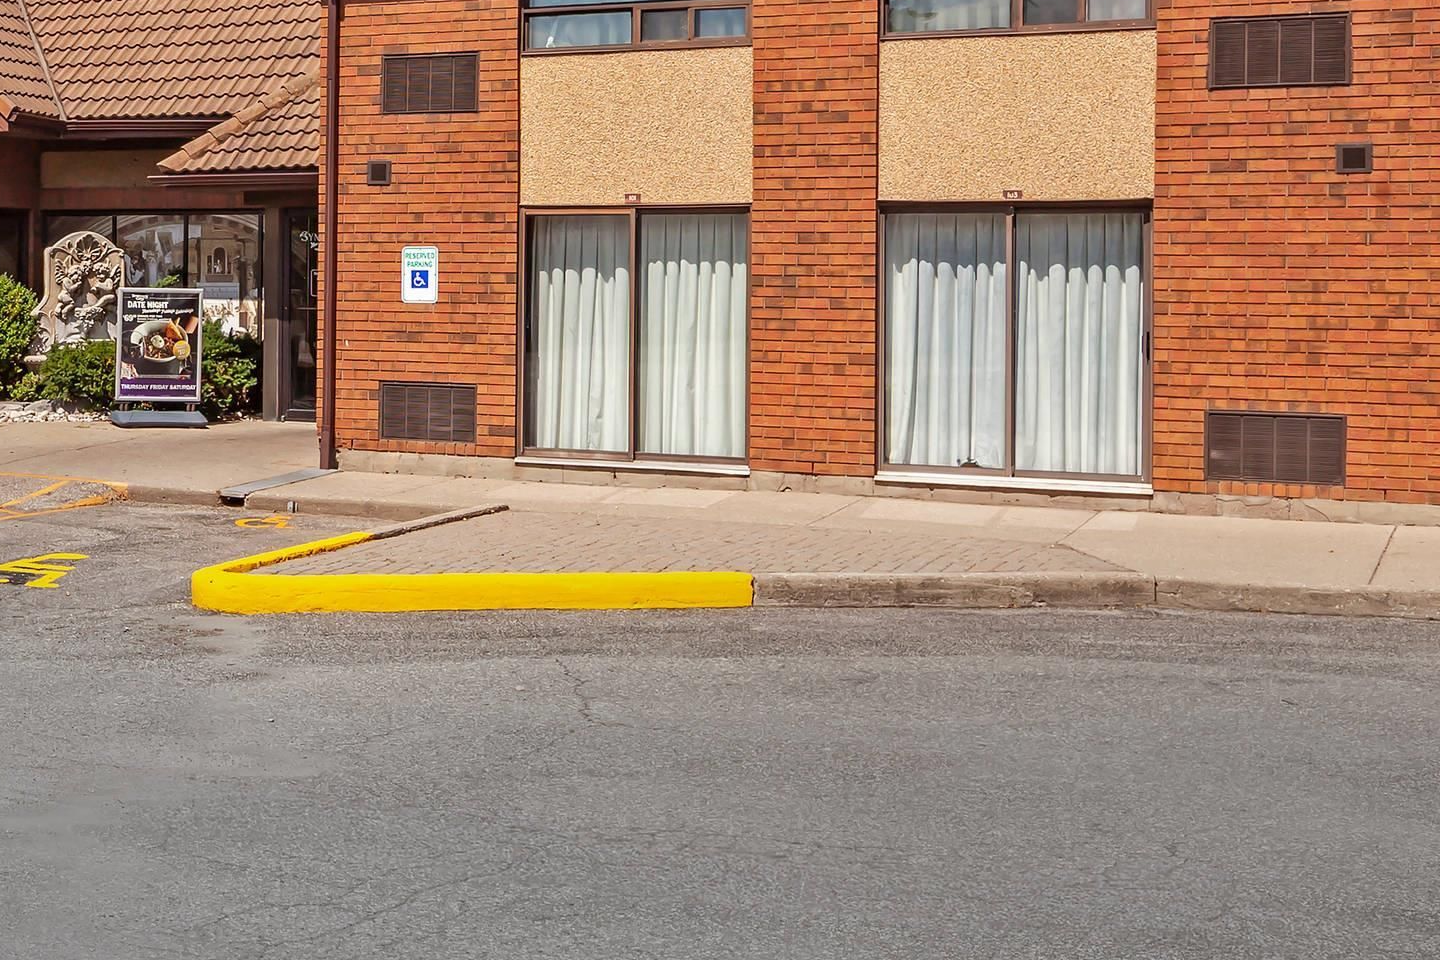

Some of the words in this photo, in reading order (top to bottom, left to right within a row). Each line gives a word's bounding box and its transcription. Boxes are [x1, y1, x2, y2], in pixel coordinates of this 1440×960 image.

[405, 252, 435, 260] RESERVED
[407, 260, 433, 268] PARKING
[127, 301, 147, 309] DATE
[147, 301, 169, 309] NIGHT
[121, 383, 149, 391] THURSDAY
